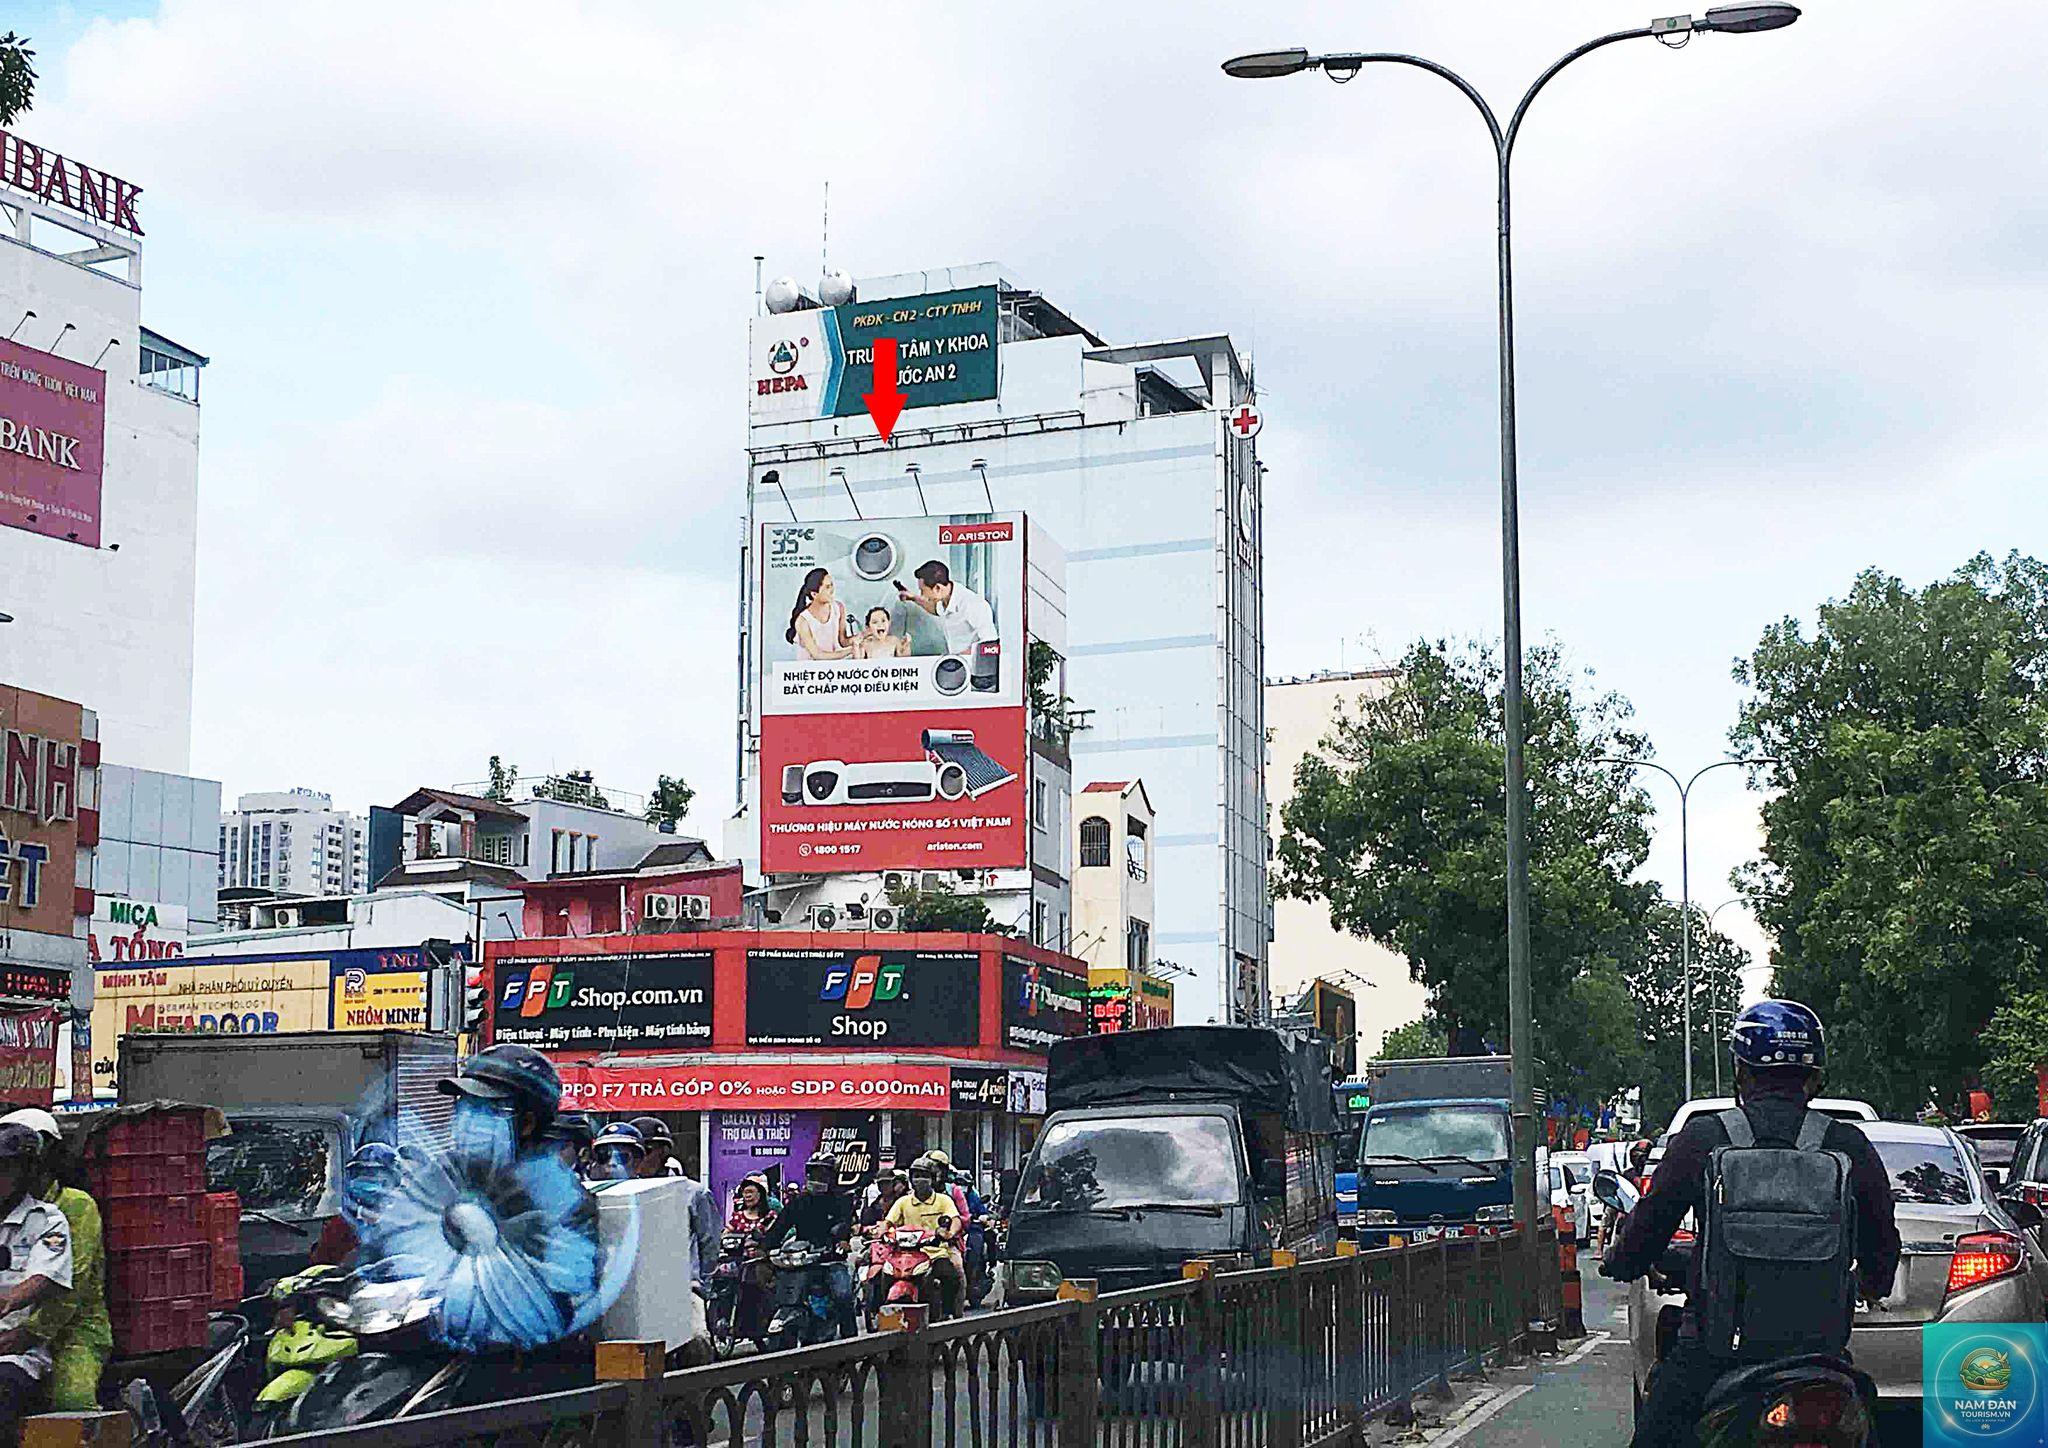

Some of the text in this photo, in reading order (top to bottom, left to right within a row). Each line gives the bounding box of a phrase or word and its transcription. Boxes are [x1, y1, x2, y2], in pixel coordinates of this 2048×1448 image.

[853, 312, 883, 328] PKĐK
[926, 305, 948, 318] CTY
[952, 300, 982, 315] TNHH
[847, 333, 989, 366] TRU TÂM Y KHOA
[924, 364, 945, 382] AN
[947, 362, 957, 379] 2
[757, 374, 808, 396] HEPA
[0, 417, 82, 471] BANK
[957, 530, 1010, 542] ARISTON
[783, 667, 918, 683] NHIỆT ĐỘ NƯỚC ỔN ĐỊNH
[783, 680, 919, 695] BẤT CHẤP MỌI ĐIỀU KIỆN
[770, 816, 1011, 834] THƯƠNG HIỆU MÁY NƯỚC NÓNG SỐ 1 VIỆT NAM
[814, 846, 837, 855] 1800
[926, 842, 983, 851] ariston.com
[138, 970, 167, 986] TÂM
[825, 972, 901, 991] FPT
[503, 980, 570, 1001] FPT
[346, 1005, 420, 1025] NHÔM MINH
[1094, 997, 1126, 1018] BẾP
[831, 1015, 887, 1040] Shop
[562, 1083, 597, 1097] PPO
[602, 1083, 625, 1097] F7
[629, 1078, 666, 1097] TRẢ
[670, 1078, 714, 1096] GÓP
[719, 1080, 752, 1096] 0%
[791, 1080, 835, 1095] SDP
[840, 1080, 945, 1097] 6.000mAh
[978, 1078, 990, 1103] 4
[722, 1112, 757, 1126] GALAXY
[722, 1127, 740, 1143] TRỢ
[741, 1127, 756, 1140] GIÁ
[766, 1126, 791, 1142] TRIỆU
